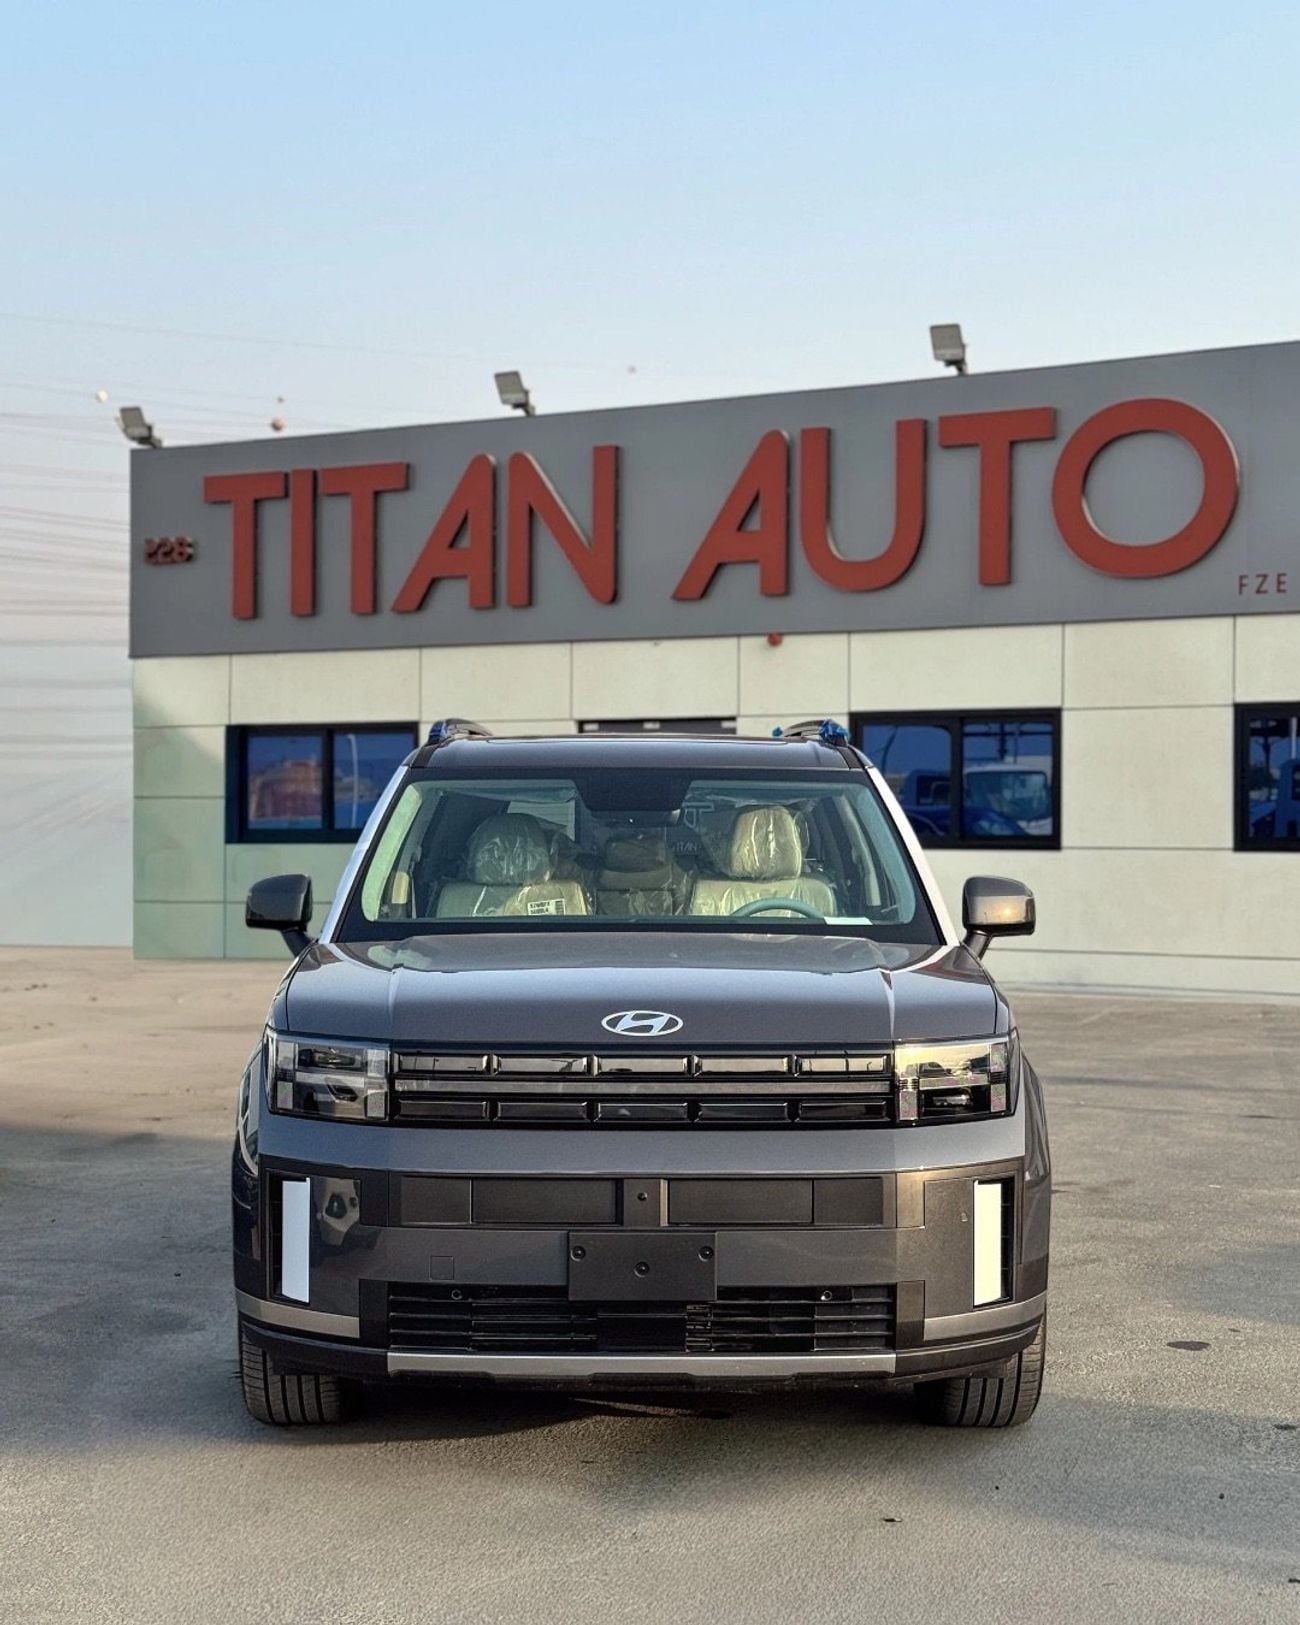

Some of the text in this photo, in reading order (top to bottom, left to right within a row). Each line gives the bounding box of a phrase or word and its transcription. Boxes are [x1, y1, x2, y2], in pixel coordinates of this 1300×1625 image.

[203, 398, 1240, 620] TITAN AUTO
[1238, 572, 1287, 596] FZE
